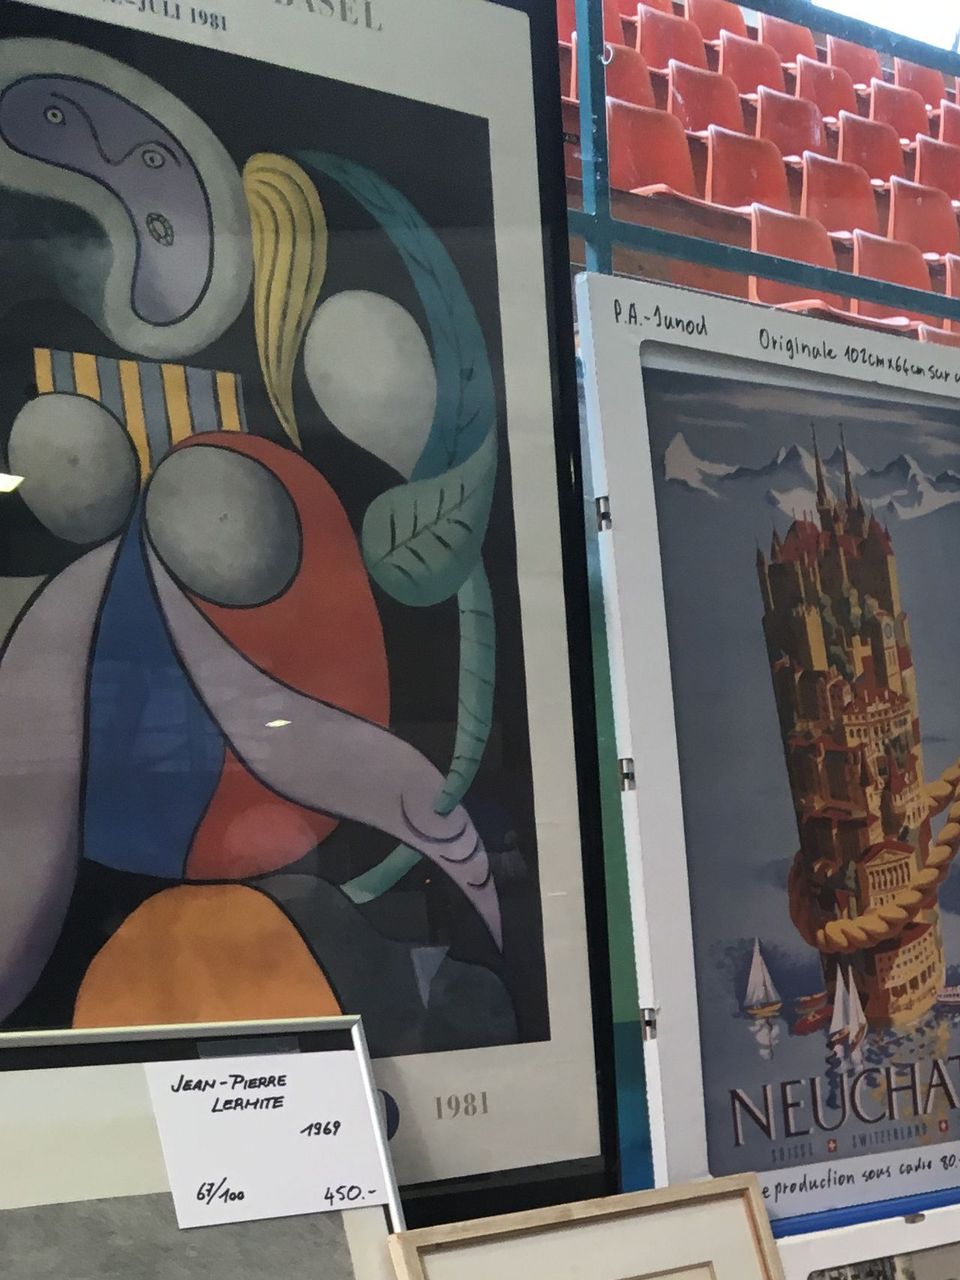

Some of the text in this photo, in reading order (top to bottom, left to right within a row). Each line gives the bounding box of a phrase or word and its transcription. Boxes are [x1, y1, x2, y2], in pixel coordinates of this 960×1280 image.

[190, 7, 229, 32] 1981
[759, 327, 838, 361] Originale
[171, 1074, 288, 1094] JEAN-PIERRE
[211, 1096, 286, 1114] LERMITE
[433, 1091, 489, 1120] 1981
[300, 1120, 342, 1137] 1969
[852, 1122, 929, 1150] SWITZERLAND
[196, 1177, 246, 1205] 67/100
[762, 1168, 855, 1203] eproduction
